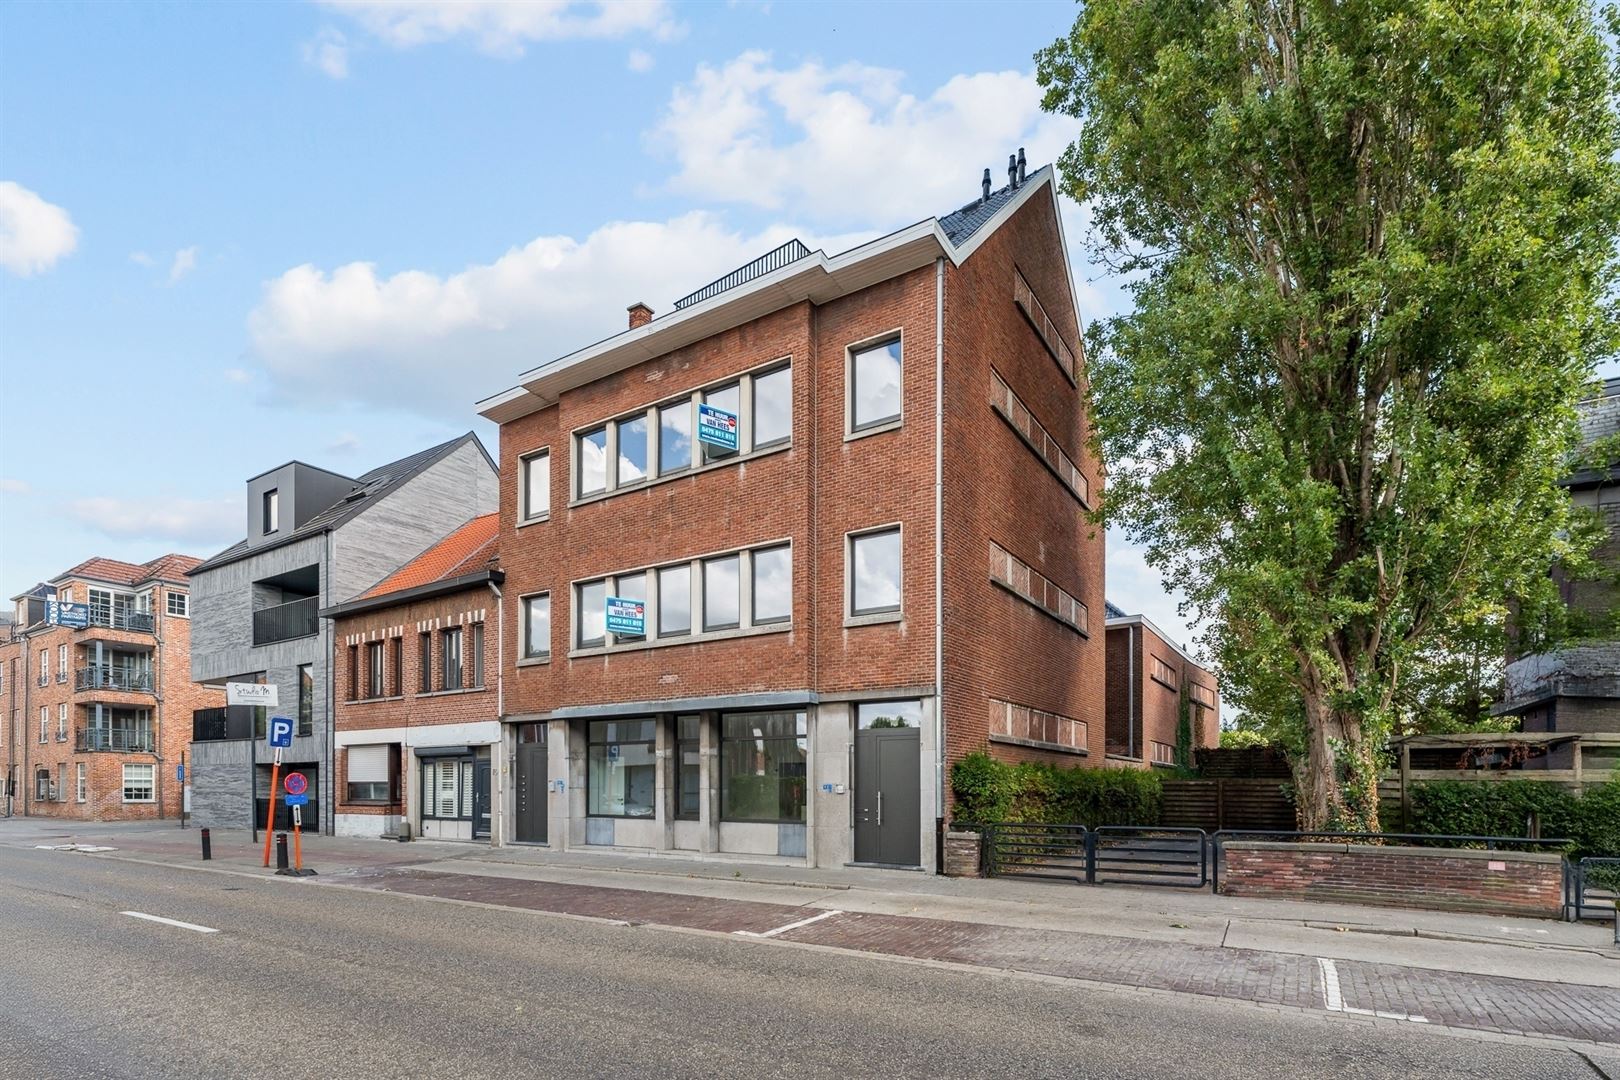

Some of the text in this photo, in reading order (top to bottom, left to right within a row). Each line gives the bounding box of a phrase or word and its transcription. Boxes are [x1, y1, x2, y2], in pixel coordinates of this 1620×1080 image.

[706, 418, 717, 427] VAN
[717, 421, 730, 431] HEES
[273, 722, 290, 743] P
